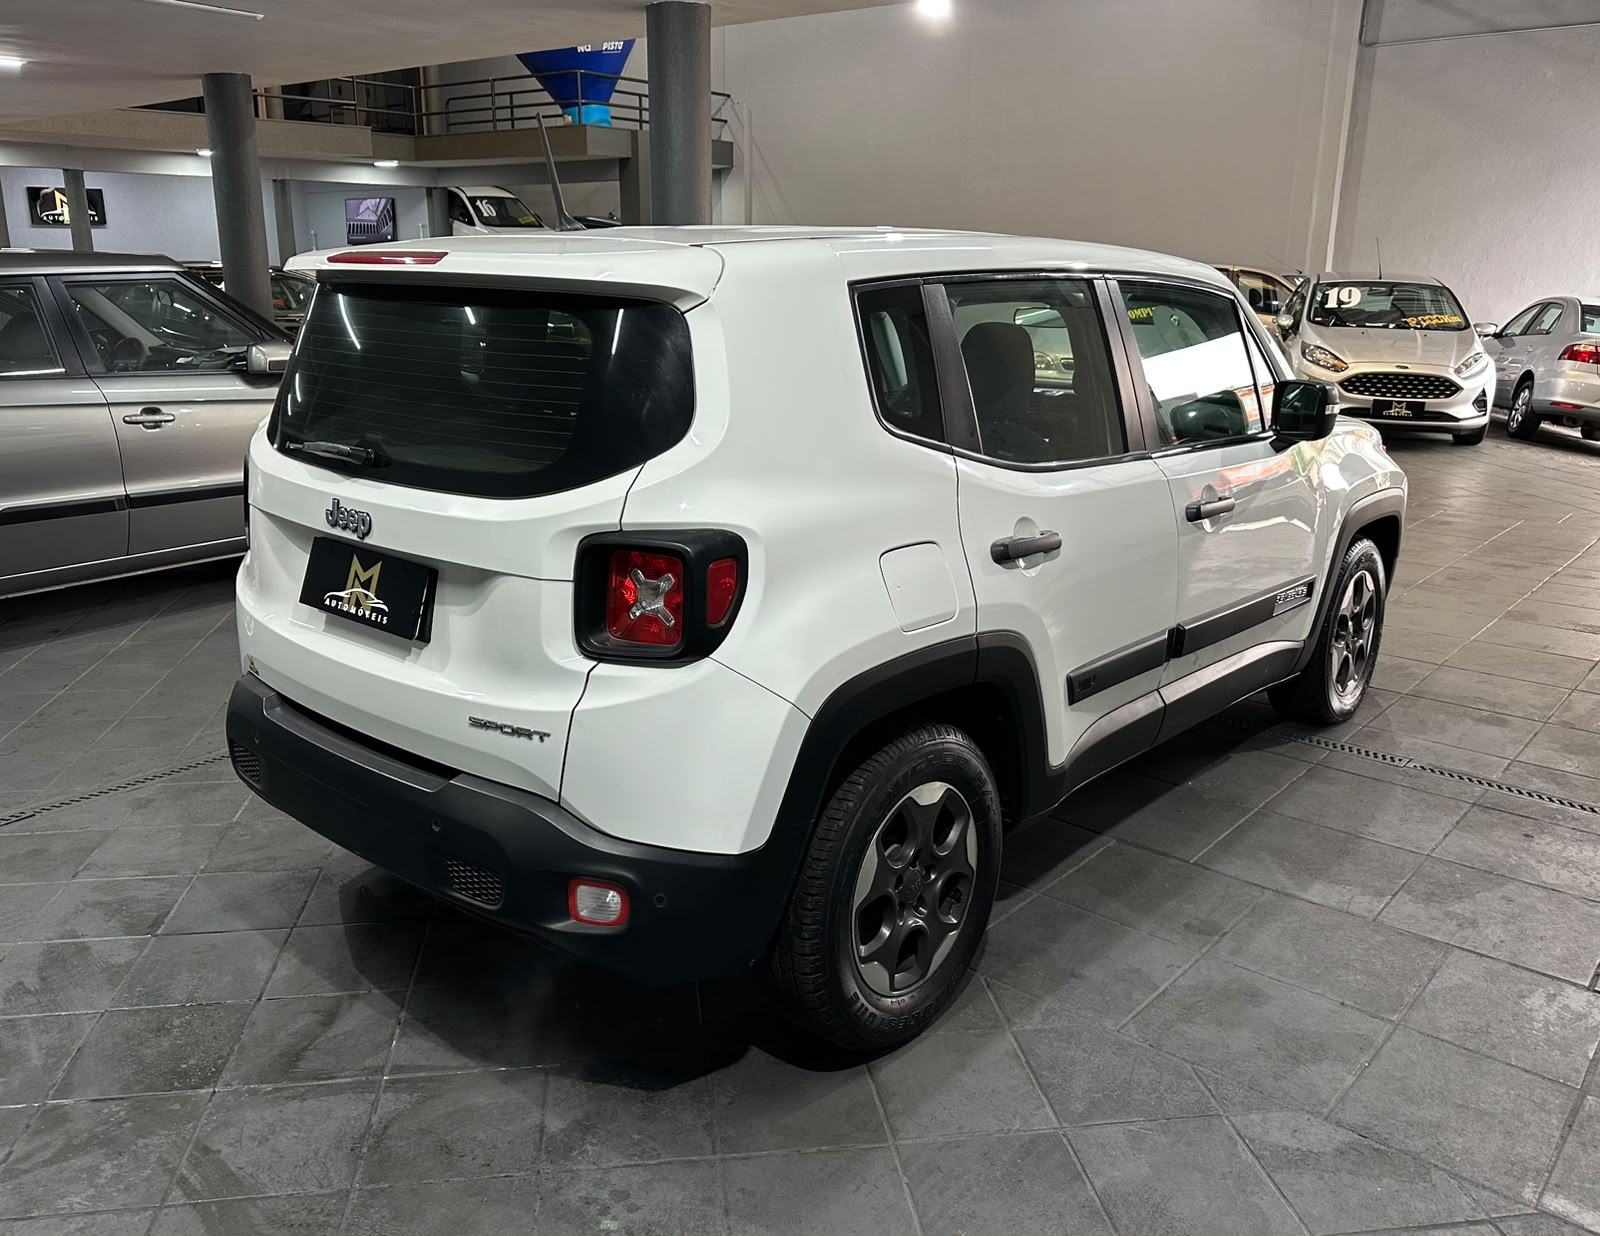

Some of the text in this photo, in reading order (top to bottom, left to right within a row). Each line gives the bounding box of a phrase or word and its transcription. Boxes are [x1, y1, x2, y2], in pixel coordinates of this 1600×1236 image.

[475, 199, 497, 217] 16
[1324, 286, 1362, 309] 19
[325, 498, 372, 540] Jeep
[467, 715, 552, 743] SPORT
